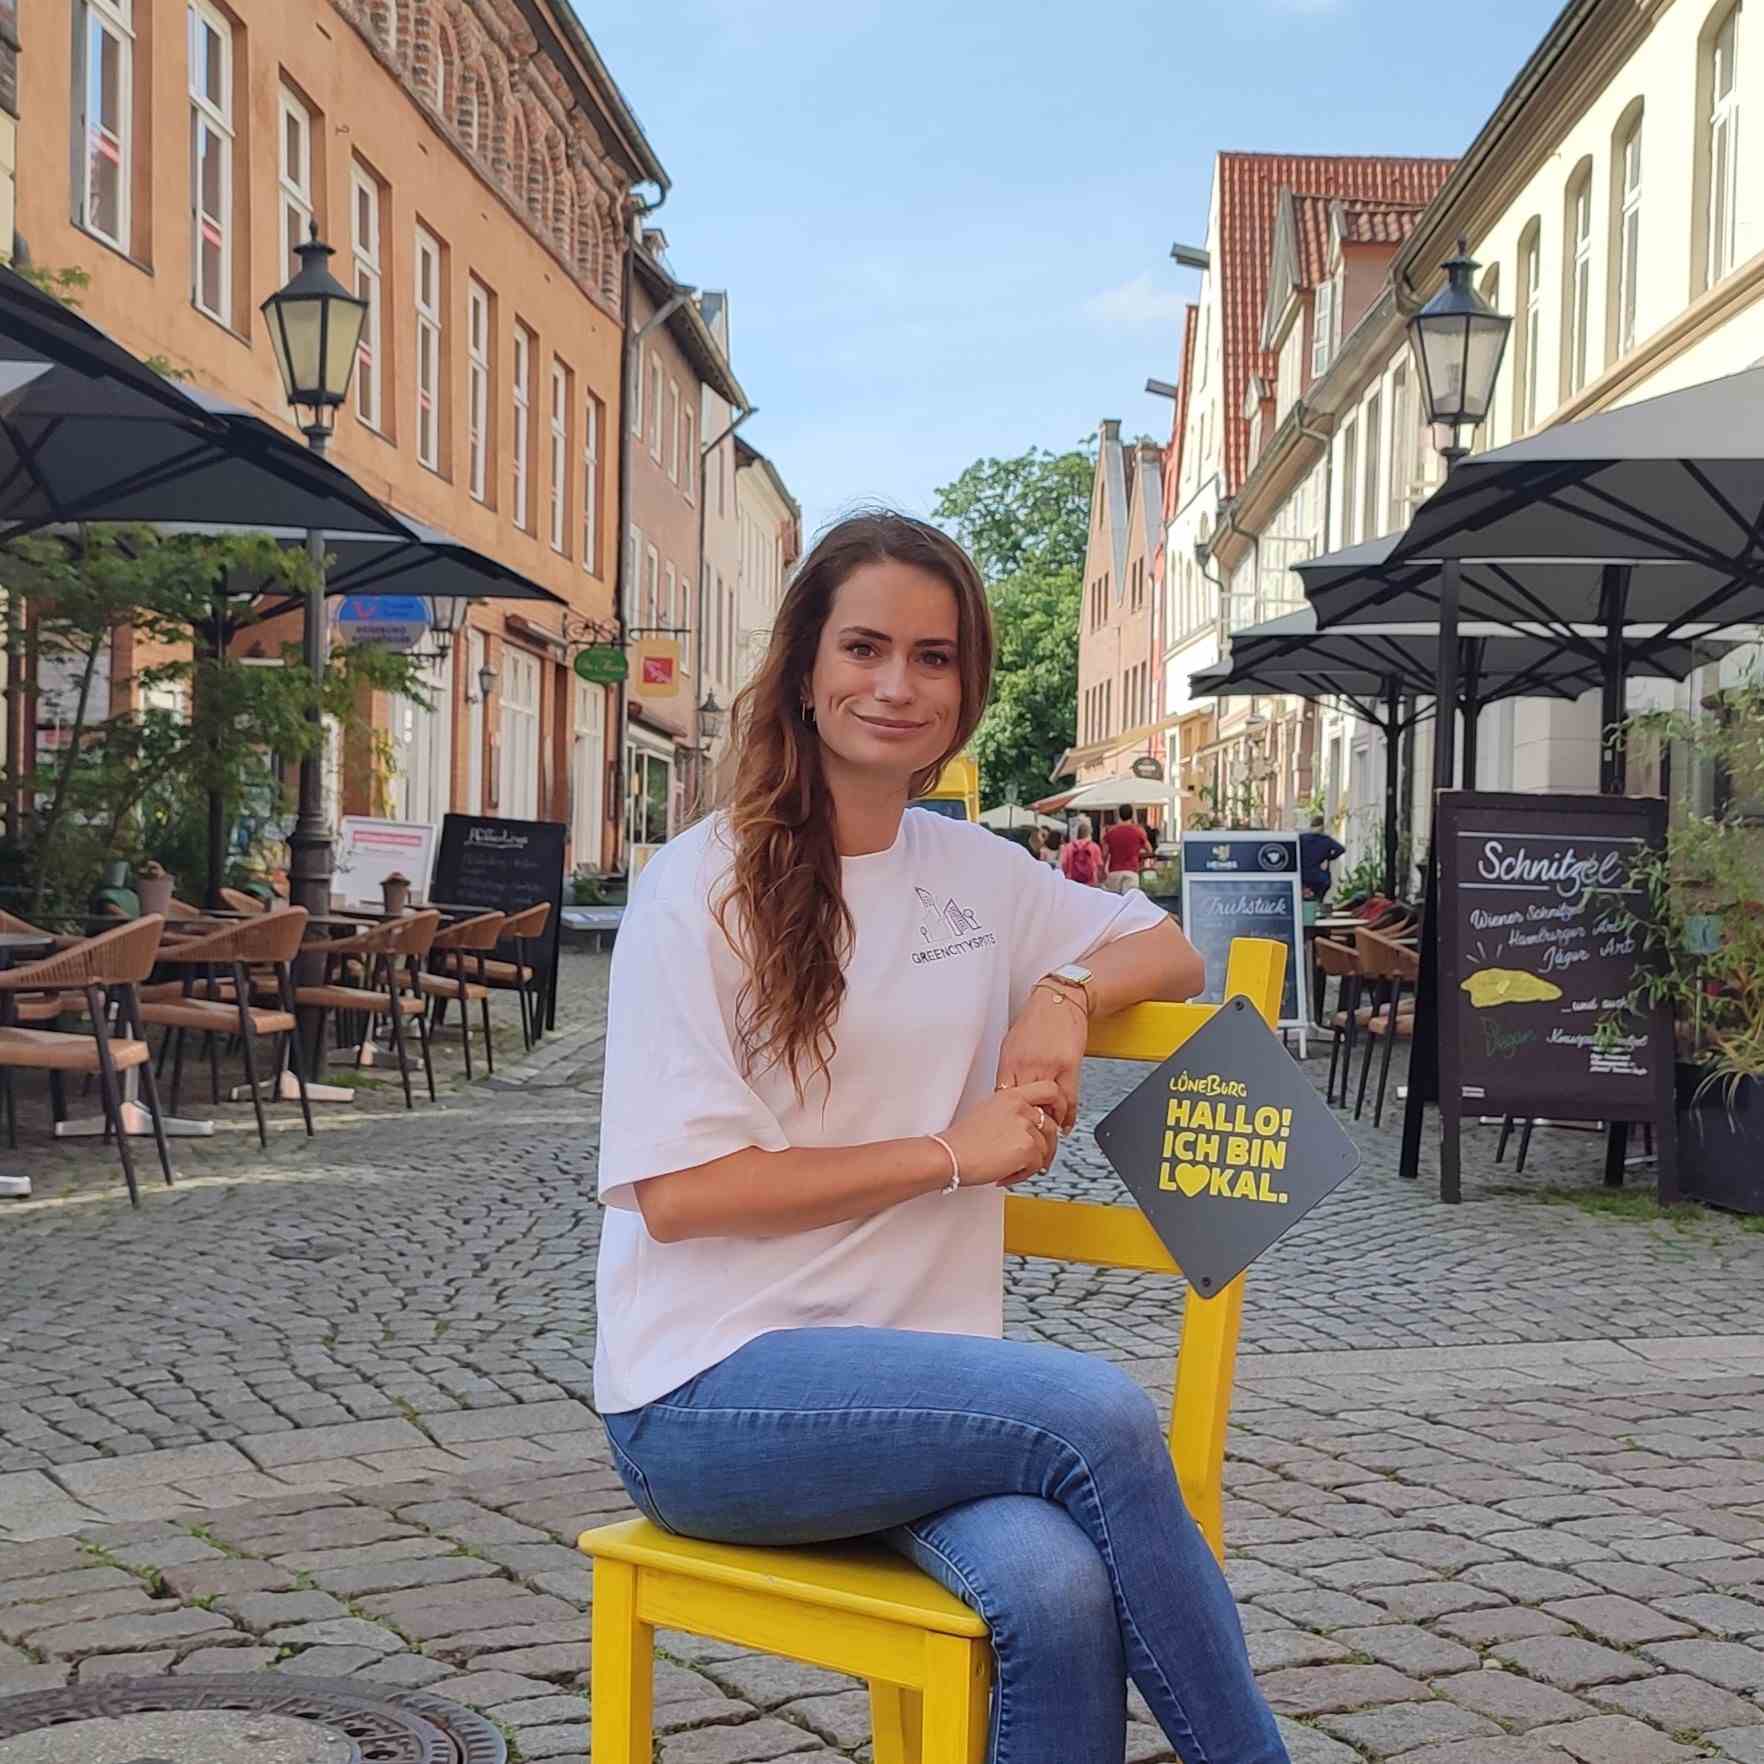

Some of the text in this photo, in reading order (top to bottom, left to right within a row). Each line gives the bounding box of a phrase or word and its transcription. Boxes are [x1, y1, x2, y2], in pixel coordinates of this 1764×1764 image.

[1477, 840, 1622, 898] Schnitzel
[1470, 909, 1524, 930] Wiener
[1508, 925, 1586, 946] Hamburger
[1600, 936, 1634, 956] Art
[1167, 1098, 1293, 1137] HALLO!
[1162, 1130, 1287, 1170] ICH BIN
